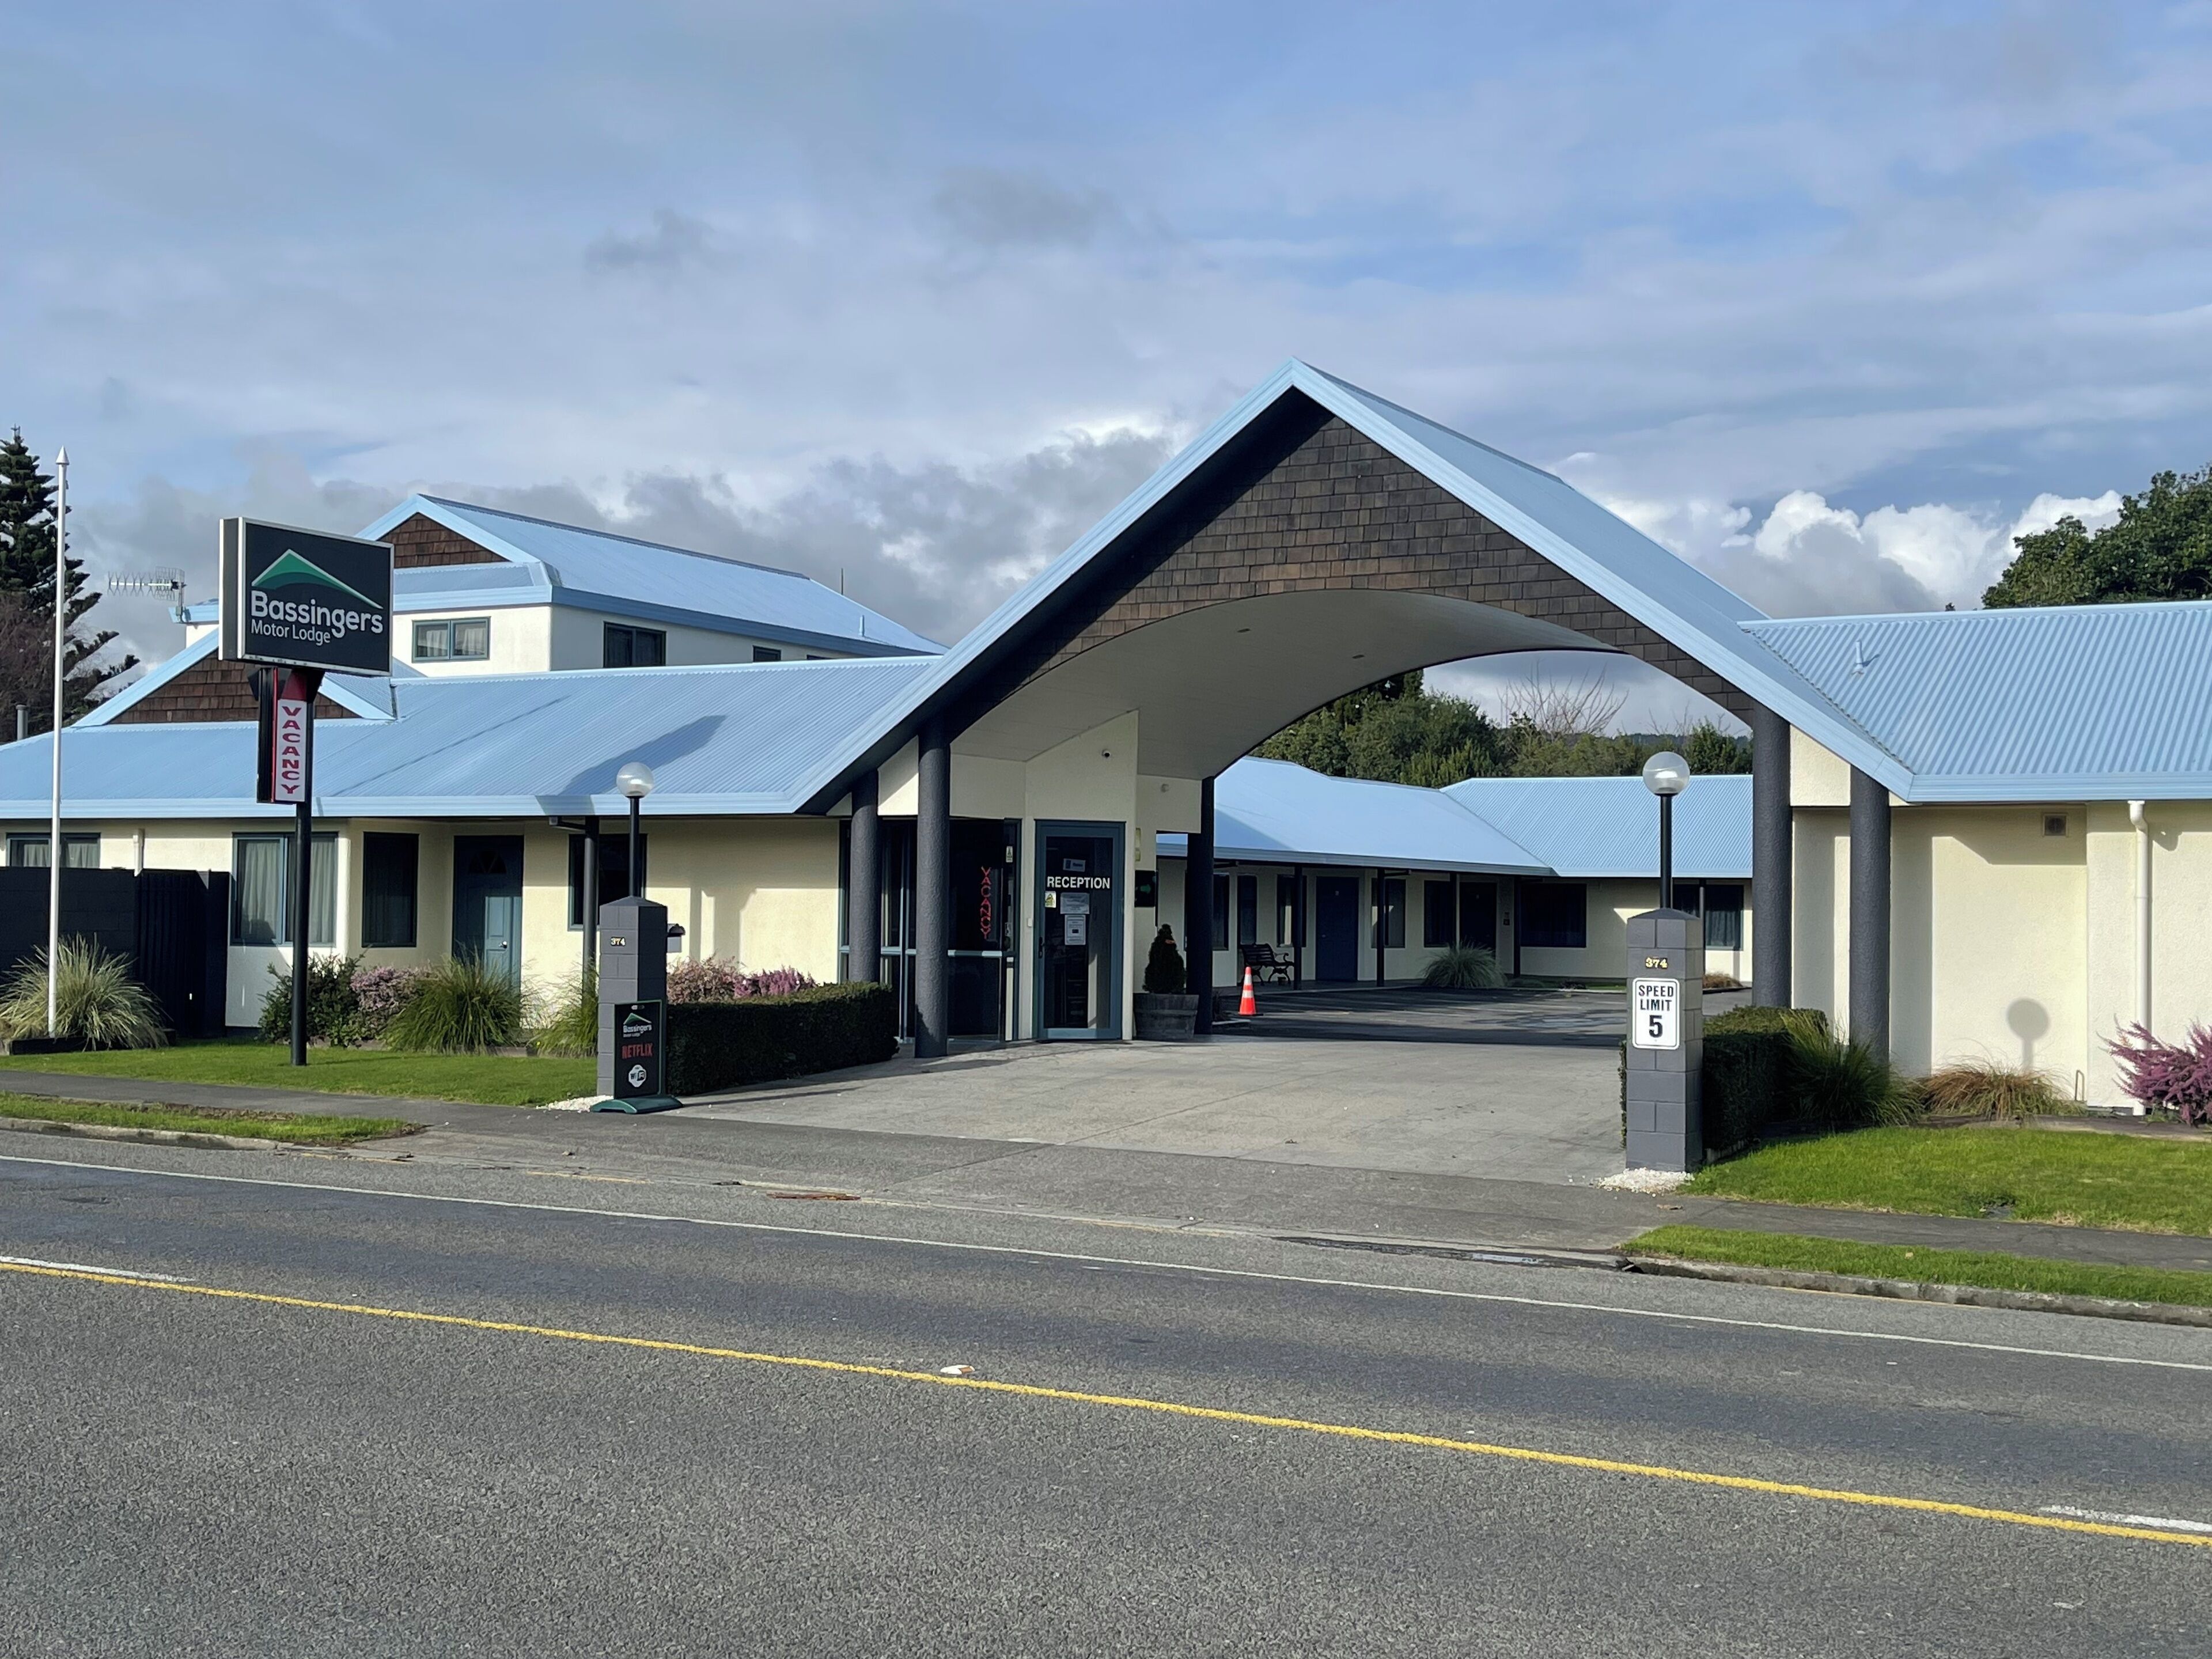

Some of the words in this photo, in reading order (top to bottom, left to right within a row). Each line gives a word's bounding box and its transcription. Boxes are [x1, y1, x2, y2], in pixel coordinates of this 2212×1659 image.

[251, 590, 384, 638] Bassingers
[251, 619, 290, 638] Motor
[292, 624, 331, 646] Lodge
[281, 706, 302, 794] VACANCY
[1047, 876, 1110, 889] RECEPTION
[980, 866, 992, 940] VACANCY
[611, 937, 626, 946] 374
[1645, 957, 1668, 968] 374
[1638, 984, 1674, 997] SPEED
[1640, 998, 1672, 1012] LIMIT
[1649, 1014, 1663, 1038] 5
[622, 1043, 653, 1060] NETFLIX
